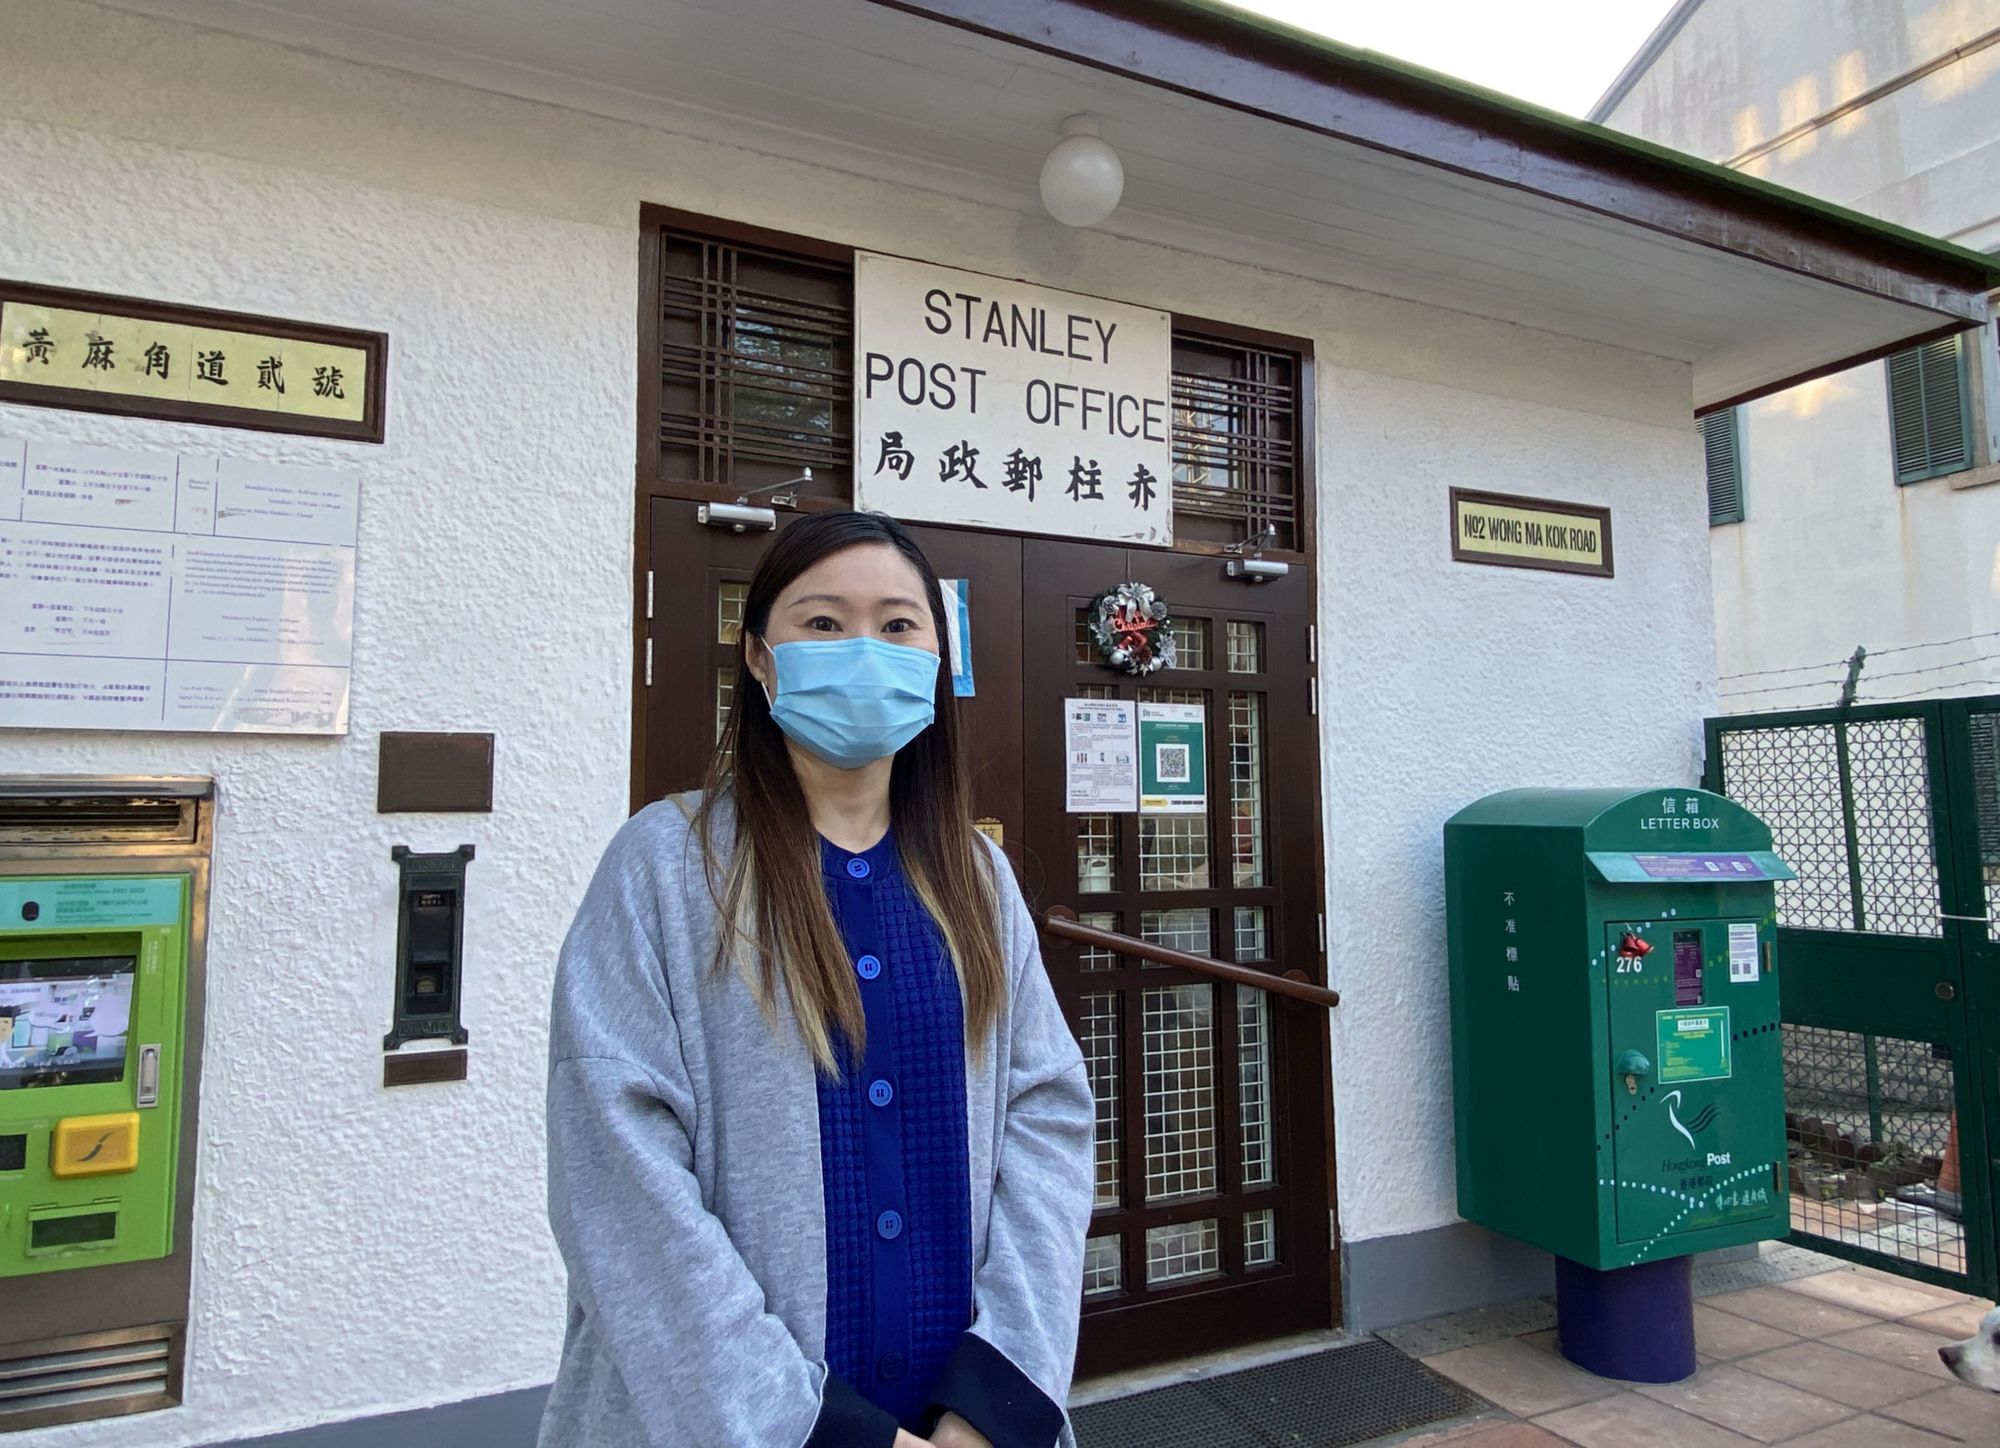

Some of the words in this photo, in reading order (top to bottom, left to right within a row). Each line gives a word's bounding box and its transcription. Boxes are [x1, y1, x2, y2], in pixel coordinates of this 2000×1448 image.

[924, 289, 1117, 364] STANLEY
[22, 328, 345, 399] 黃麻角道貳號
[866, 352, 986, 413] POST
[1026, 379, 1165, 442] OFFICE
[1488, 517, 1522, 544] WONG
[1525, 521, 1543, 547] MA
[1545, 524, 1568, 550] KOK
[1569, 528, 1597, 553] ROAD
[1640, 817, 1690, 829] LETTER
[1693, 817, 1720, 829] BOX
[1662, 796, 1700, 815] 信箱
[1503, 892, 1520, 992] 不准標貼
[1616, 956, 1642, 974] 276
[1707, 1152, 1731, 1166] Post
